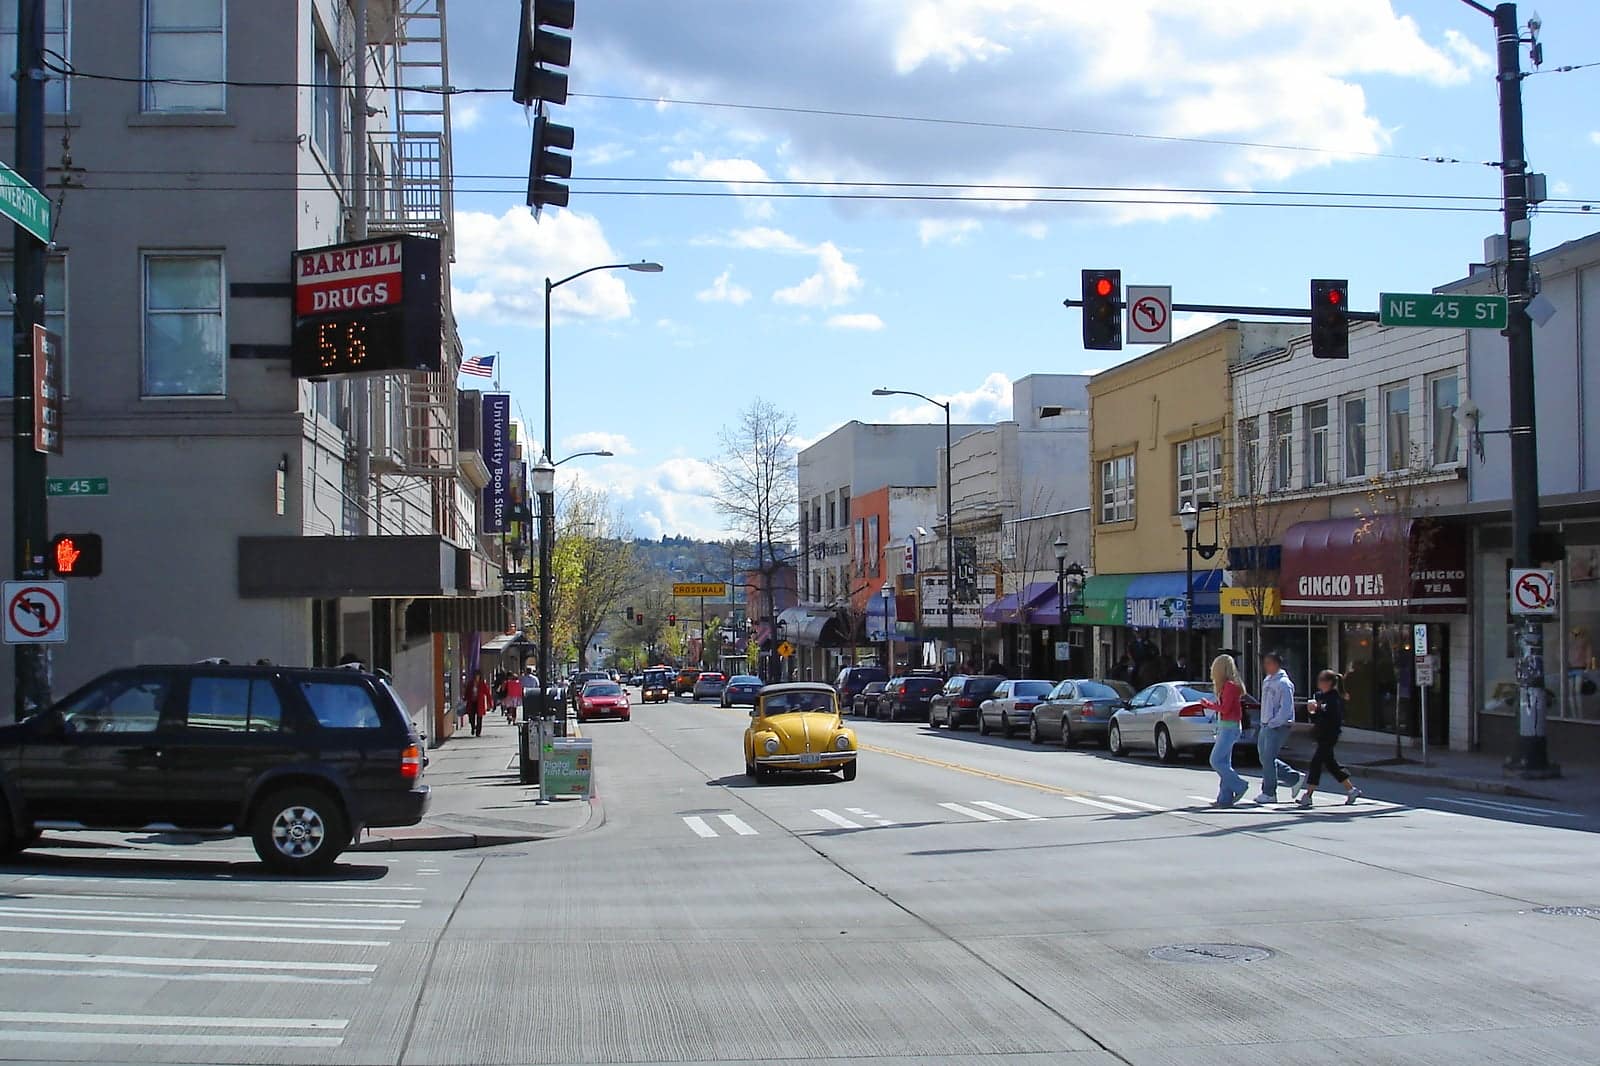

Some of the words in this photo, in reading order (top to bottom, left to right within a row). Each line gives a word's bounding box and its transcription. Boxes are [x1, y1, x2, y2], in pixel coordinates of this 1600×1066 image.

[0, 171, 37, 221] NIVERSITY
[301, 243, 400, 277] BARTELL
[313, 282, 388, 311] DRUGS
[1390, 301, 1416, 318] NE
[1431, 302, 1459, 319] 45
[1475, 303, 1498, 320] ST
[320, 321, 366, 367] 56
[491, 401, 503, 464] University
[50, 483, 63, 493] NE
[69, 480, 90, 493] 45
[494, 468, 504, 495] Book
[1299, 575, 1350, 596] GINGKO
[1355, 574, 1384, 595] TEA
[1411, 571, 1466, 580] GINGKO
[1424, 584, 1452, 593] TEA
[544, 760, 570, 770] Digital
